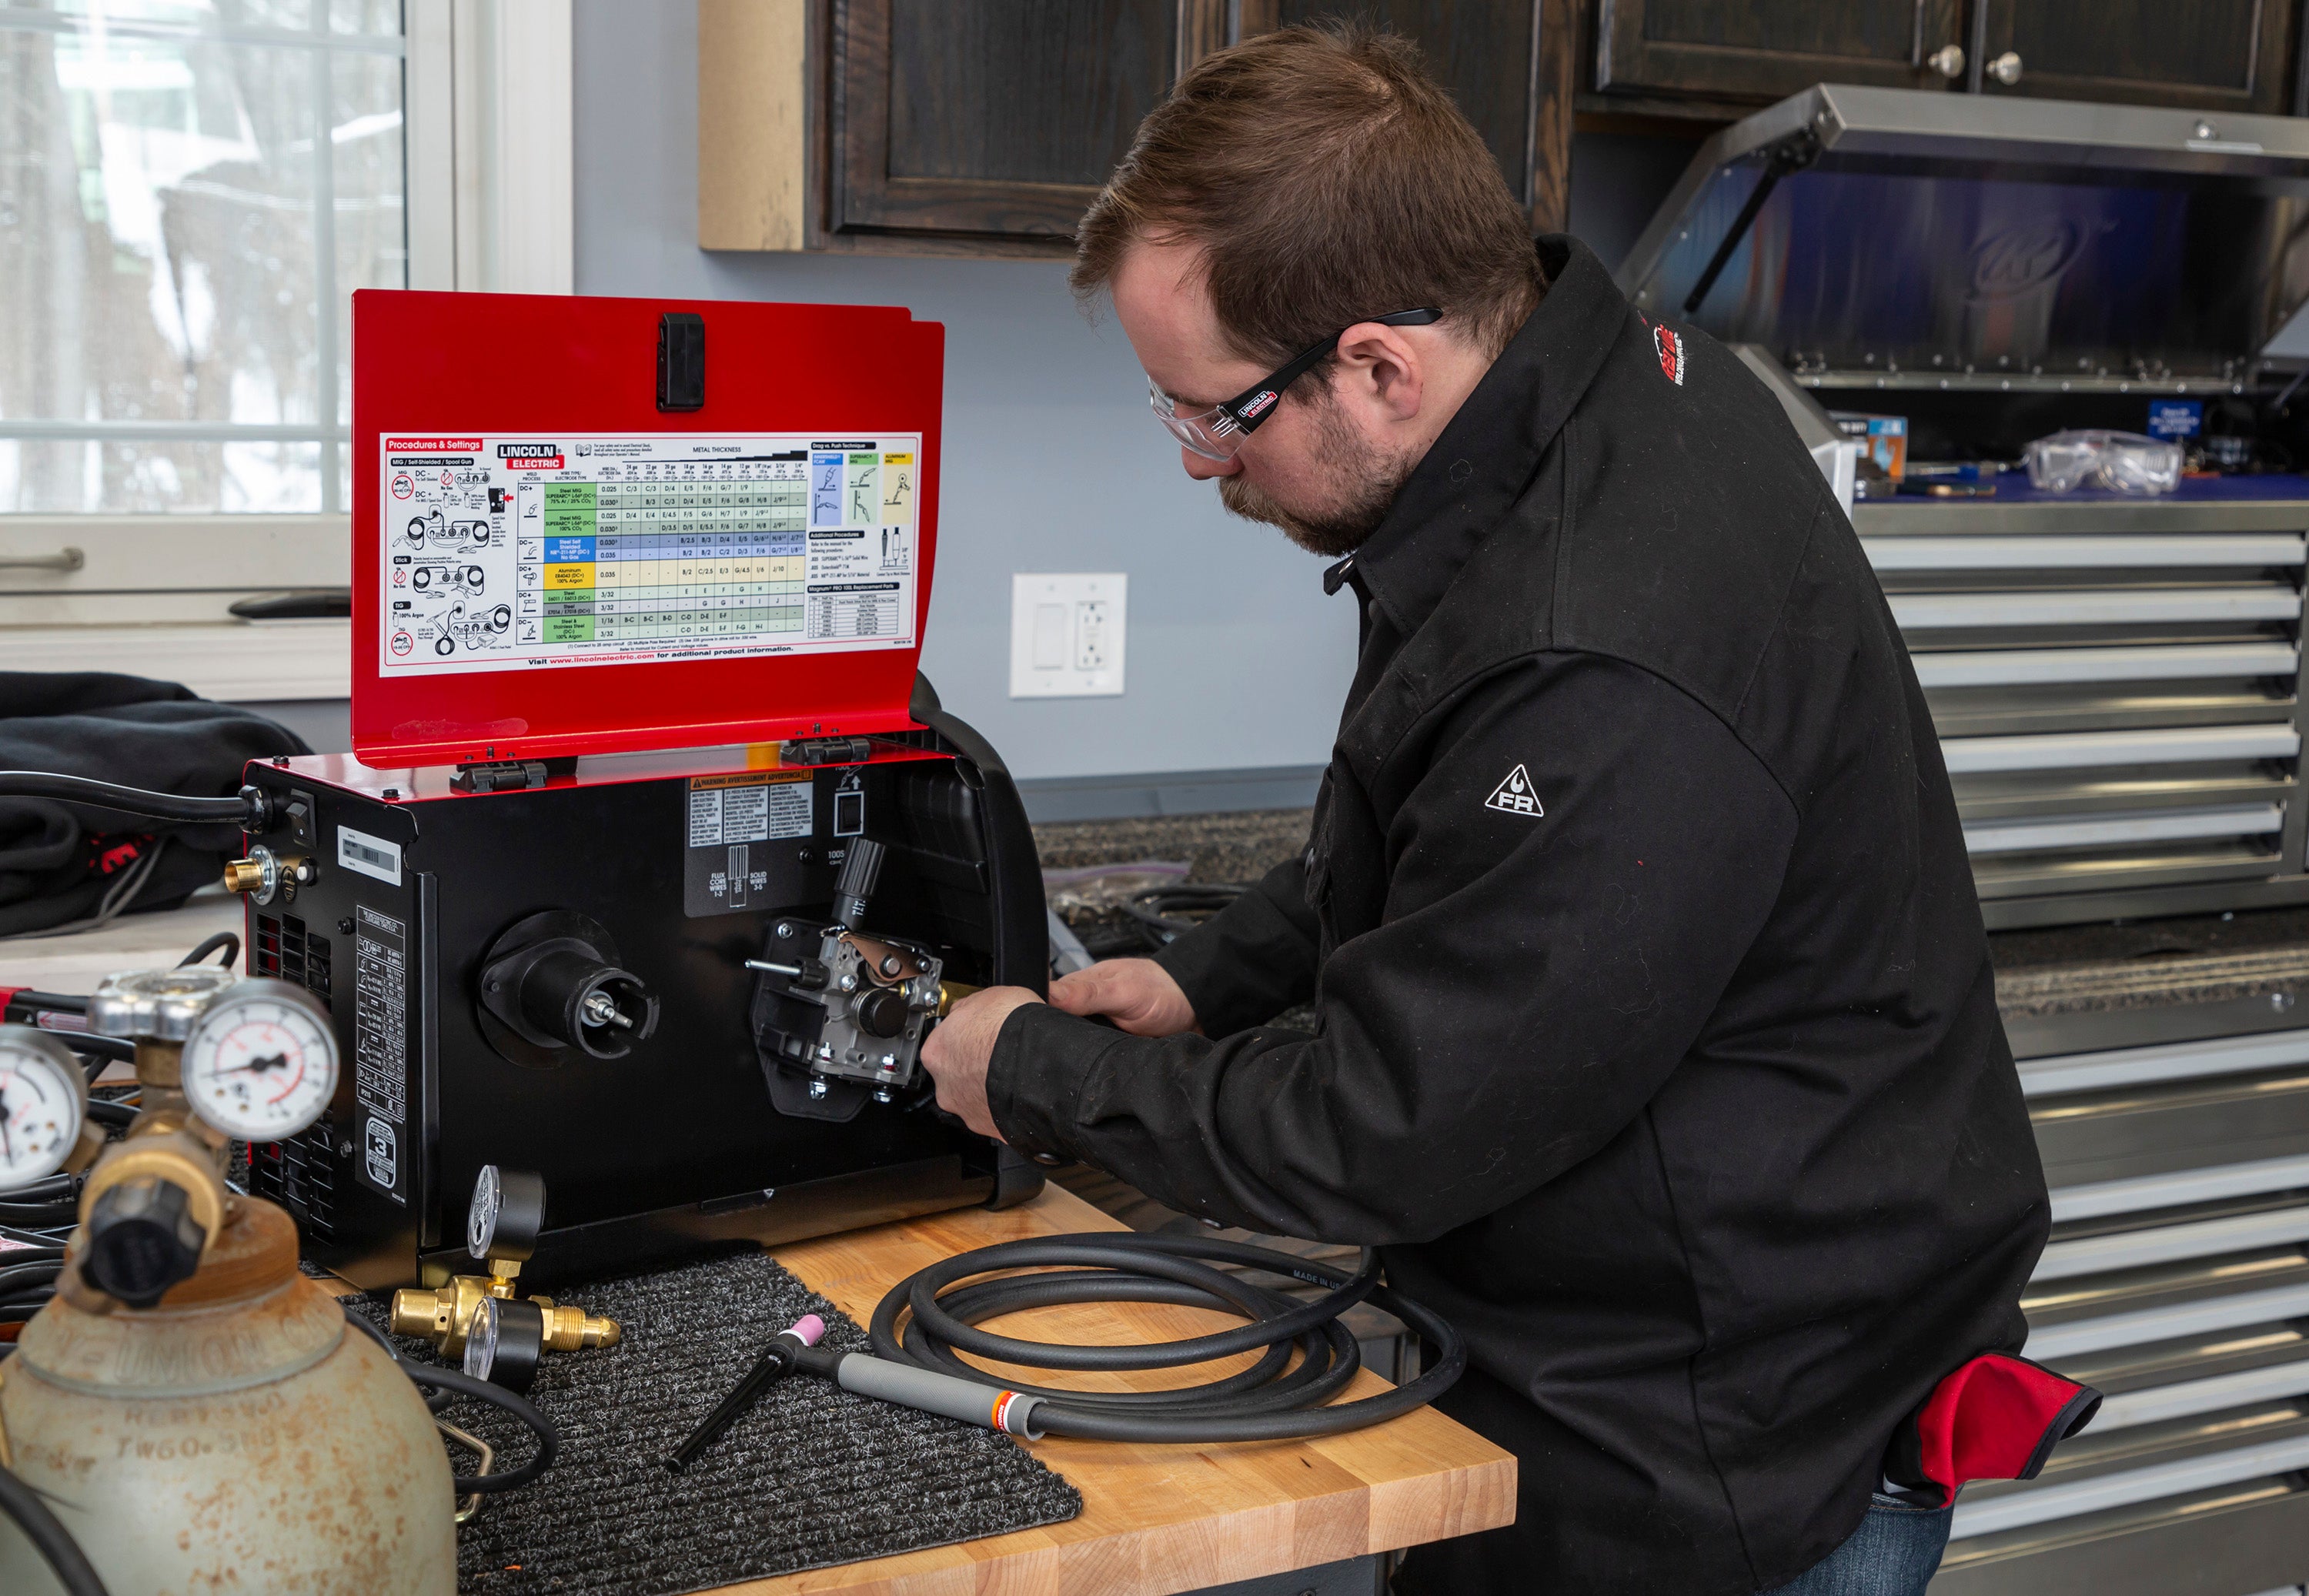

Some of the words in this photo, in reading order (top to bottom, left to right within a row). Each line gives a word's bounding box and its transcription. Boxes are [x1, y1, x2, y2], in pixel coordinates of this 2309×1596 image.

[1241, 394, 1267, 415] LINCOLN
[1251, 396, 1274, 414] ELECTRIC
[447, 441, 480, 450] Settings
[500, 446, 553, 456] LINCOLN
[513, 459, 560, 468] ELECTRIC
[550, 654, 654, 663] www.lincolnelectric.com
[727, 775, 766, 783] AVERTISSEMENT
[1498, 791, 1534, 812] FR
[375, 1137, 386, 1157] 3
[1294, 1270, 1318, 1284] MADE
